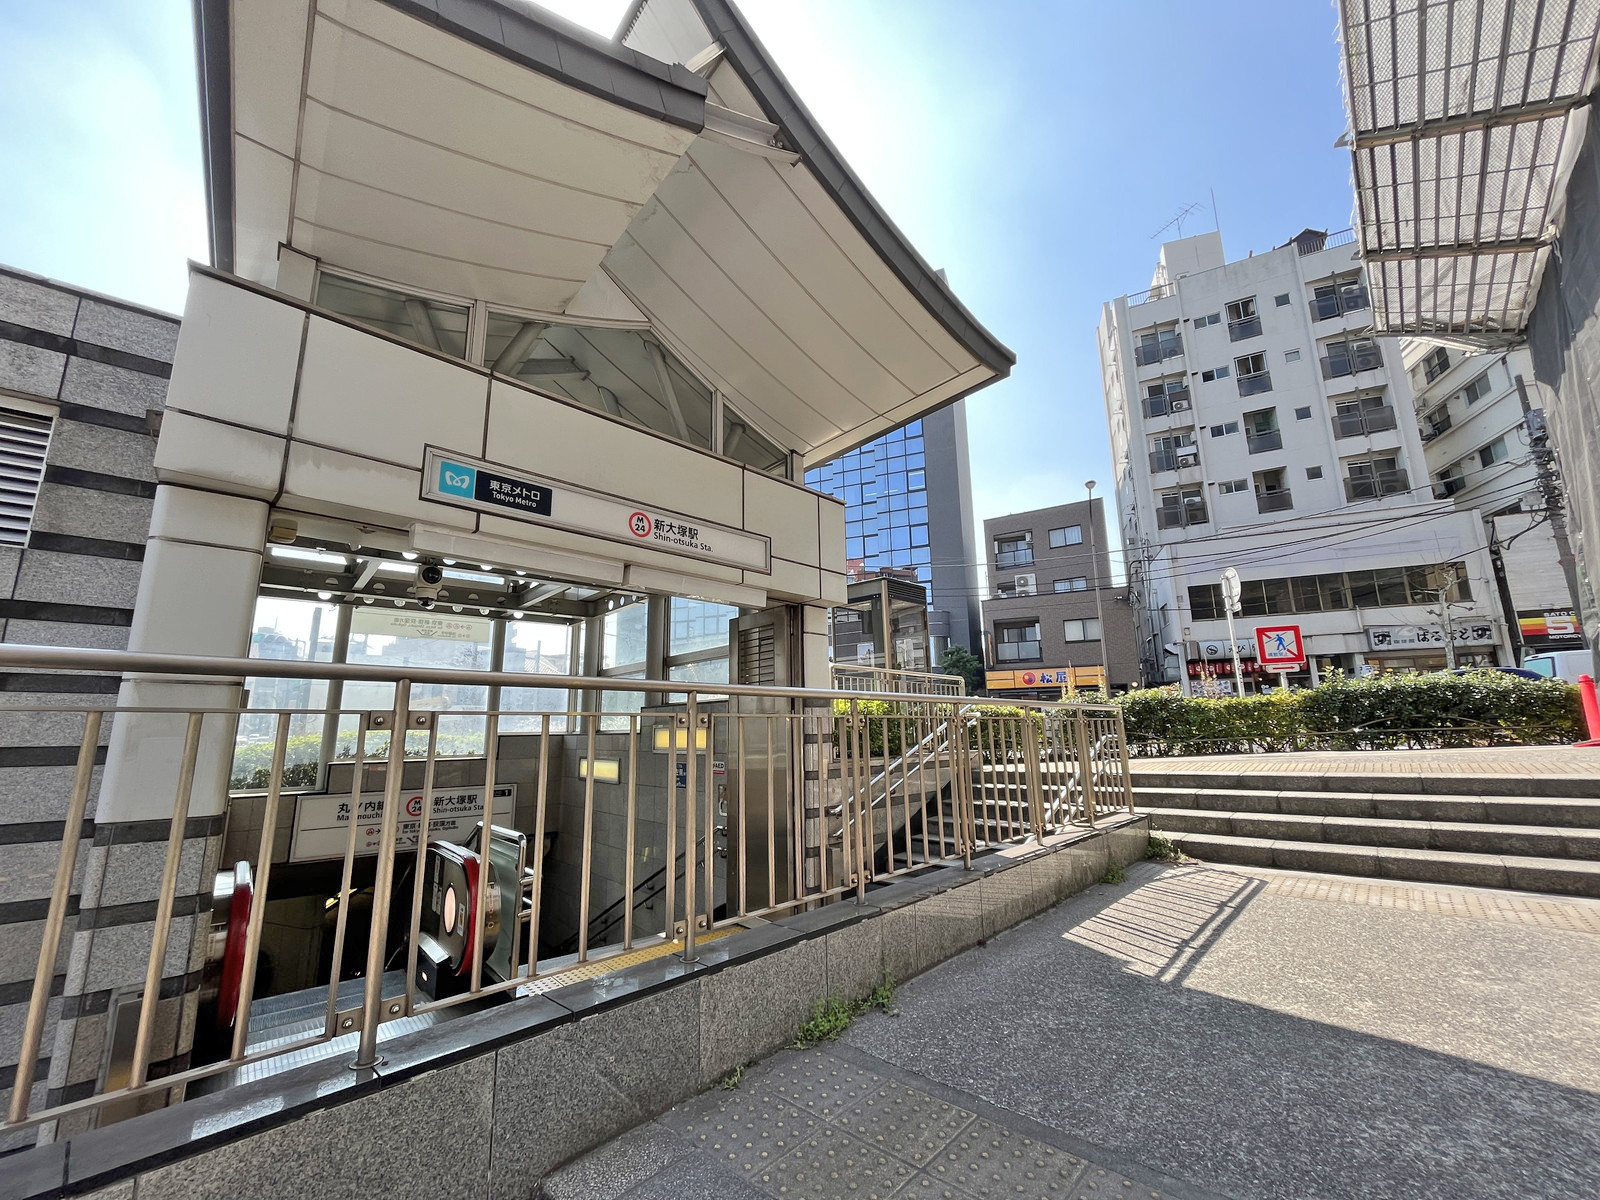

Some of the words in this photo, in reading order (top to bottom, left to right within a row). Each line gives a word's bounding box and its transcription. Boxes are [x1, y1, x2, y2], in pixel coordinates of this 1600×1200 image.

[489, 480, 541, 501] 東京メトロ
[492, 491, 514, 503] Tokyo
[515, 497, 537, 508] Metro
[636, 515, 644, 524] M
[634, 523, 646, 533] 24
[653, 519, 699, 540] 新大塚駅
[653, 531, 699, 549] Shin-otsuka
[700, 542, 714, 552] Sta.
[1040, 671, 1068, 684] 松屋
[433, 794, 478, 806] 新大塚駅
[432, 804, 472, 814] Shin-otsuka
